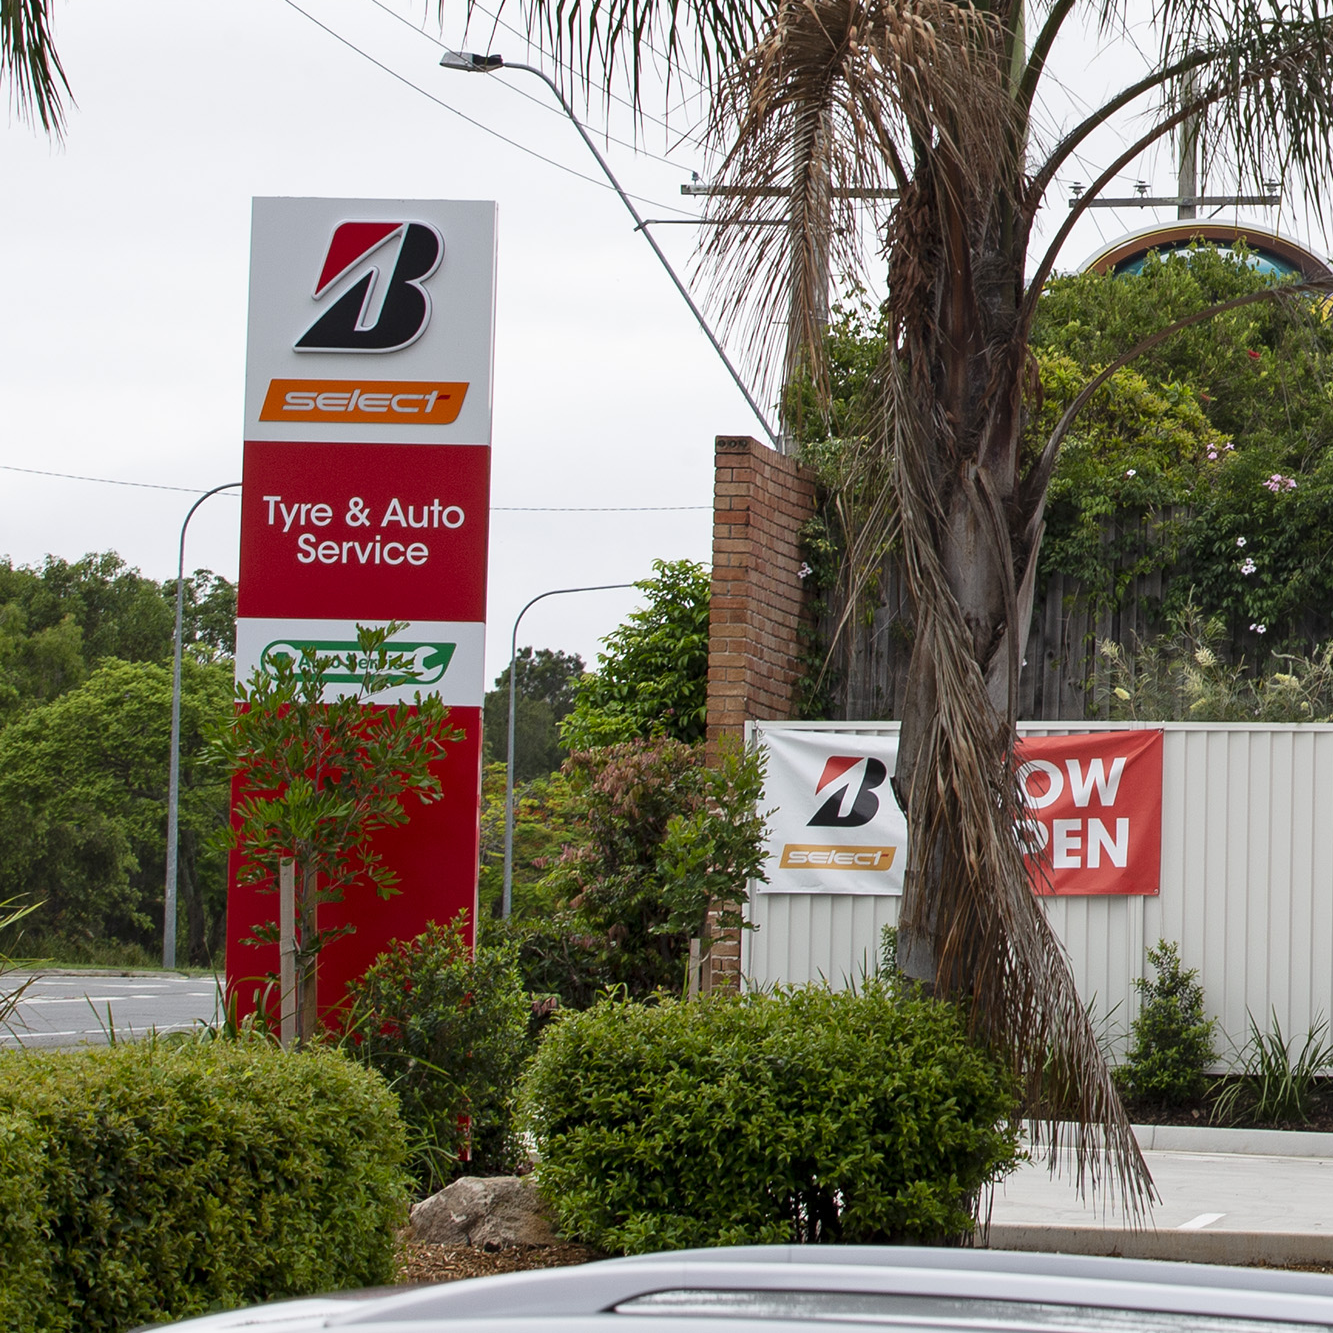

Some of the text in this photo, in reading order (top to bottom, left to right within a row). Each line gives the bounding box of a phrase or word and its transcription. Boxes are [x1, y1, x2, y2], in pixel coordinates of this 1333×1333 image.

[262, 495, 465, 533] Tyre & Auto
[297, 533, 429, 566] Service
[1014, 756, 1127, 809] OW
[1012, 817, 1130, 869] PEN
